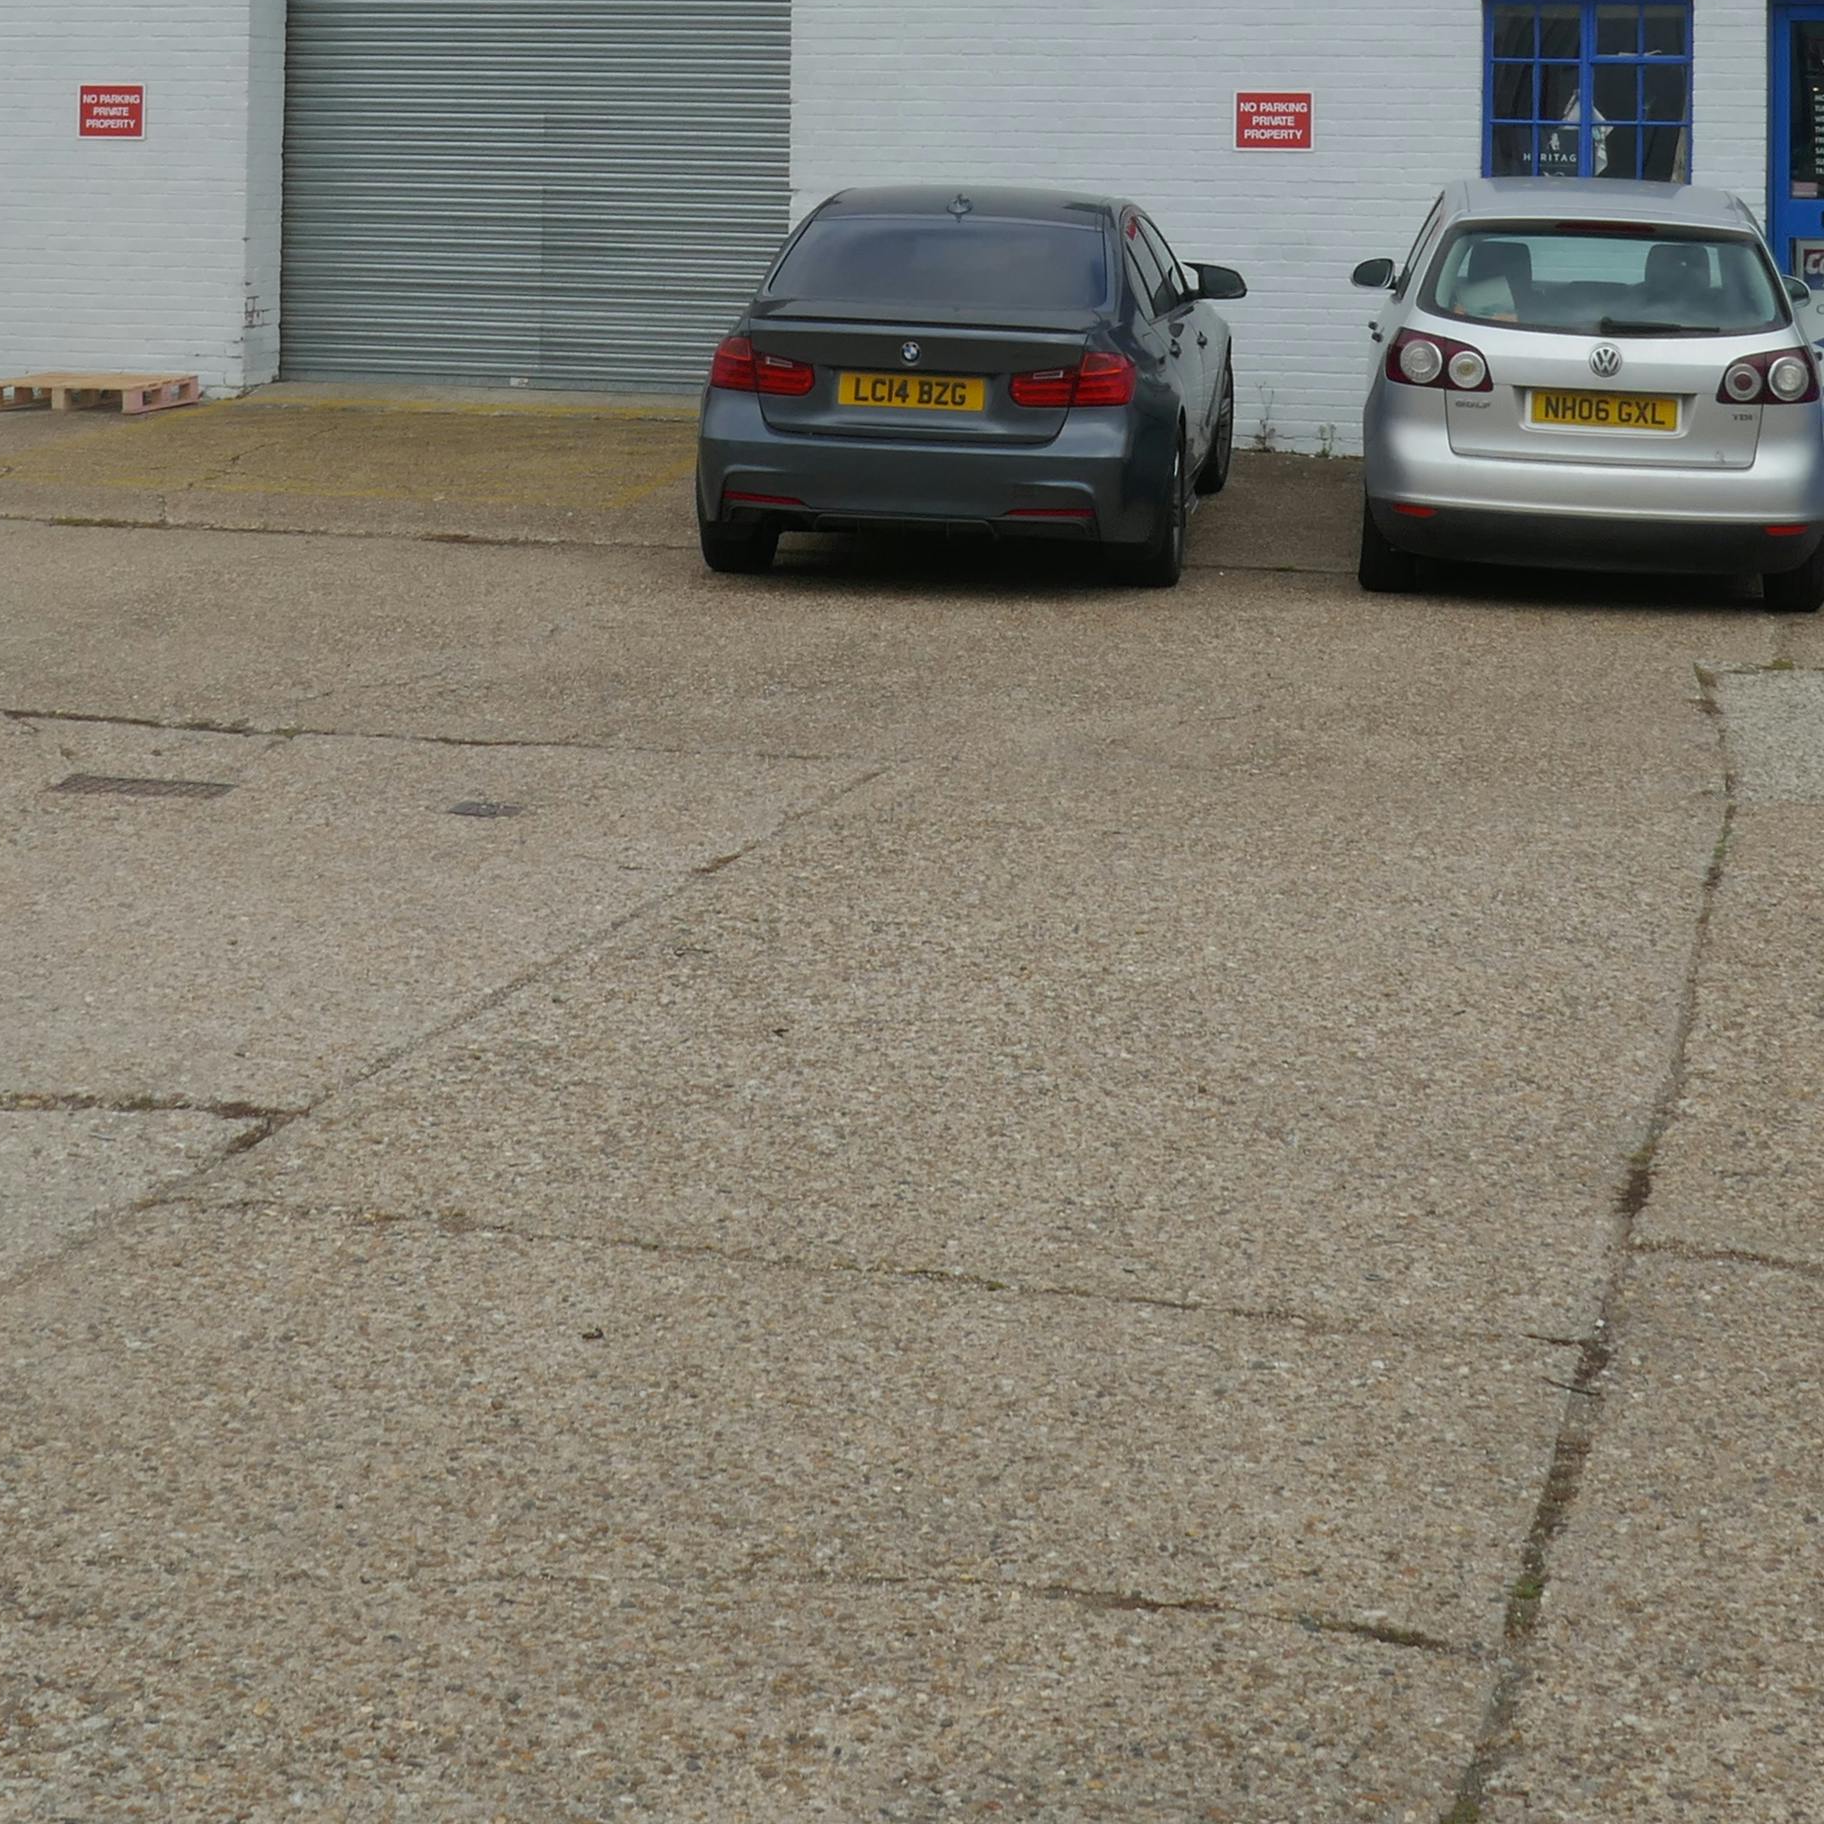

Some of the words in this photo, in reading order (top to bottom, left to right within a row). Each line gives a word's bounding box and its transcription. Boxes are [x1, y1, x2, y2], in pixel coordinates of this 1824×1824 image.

[83, 94, 97, 104] NO
[100, 94, 140, 104] PARKING
[93, 107, 129, 116] PRIVATE
[1240, 102, 1257, 112] NO
[1260, 102, 1308, 112] PARKING
[86, 119, 135, 128] PROPERTY
[1252, 116, 1295, 126] PRIVATE
[1244, 129, 1302, 139] PROPERTY
[1523, 153, 1576, 162] HRITAG
[854, 377, 909, 403] LC14
[917, 381, 967, 406] BZG
[1544, 396, 1610, 422] NH06
[1617, 401, 1665, 425] GXL
